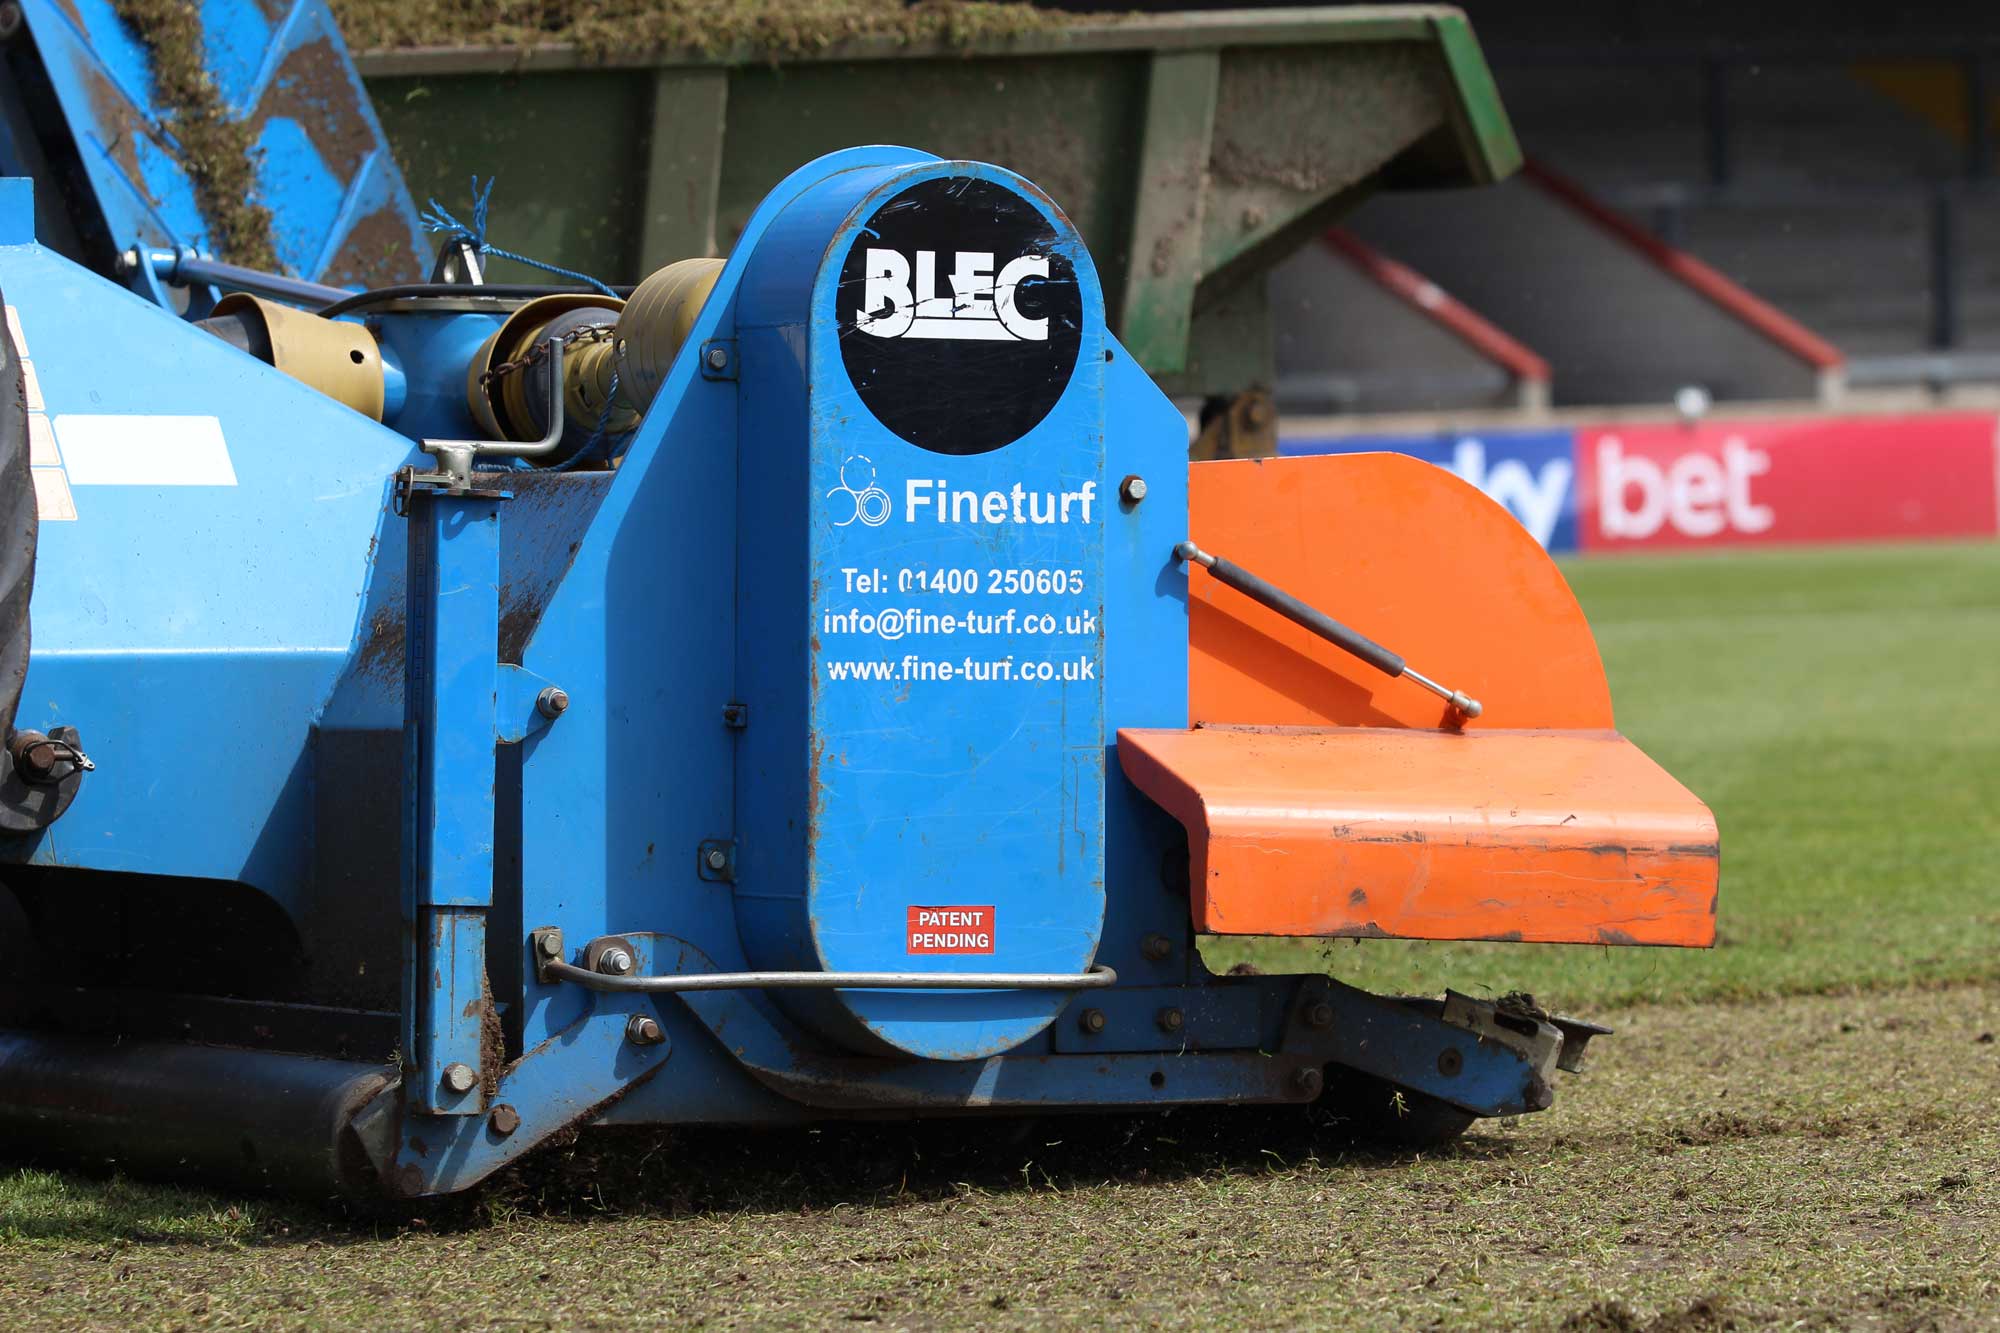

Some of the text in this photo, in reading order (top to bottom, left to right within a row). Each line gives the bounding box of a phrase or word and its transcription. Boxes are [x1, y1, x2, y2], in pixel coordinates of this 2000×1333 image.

[856, 248, 1050, 341] BLEC
[905, 478, 1097, 524] Fineturf
[1596, 435, 1775, 538] bet
[841, 568, 1084, 595] Tel: 01400 250605
[824, 608, 1097, 640] info@fine-turf.co.uk
[827, 655, 1095, 681] www.fine-turf.co.uk
[919, 911, 984, 926] PATENT
[912, 933, 989, 948] PENDING
